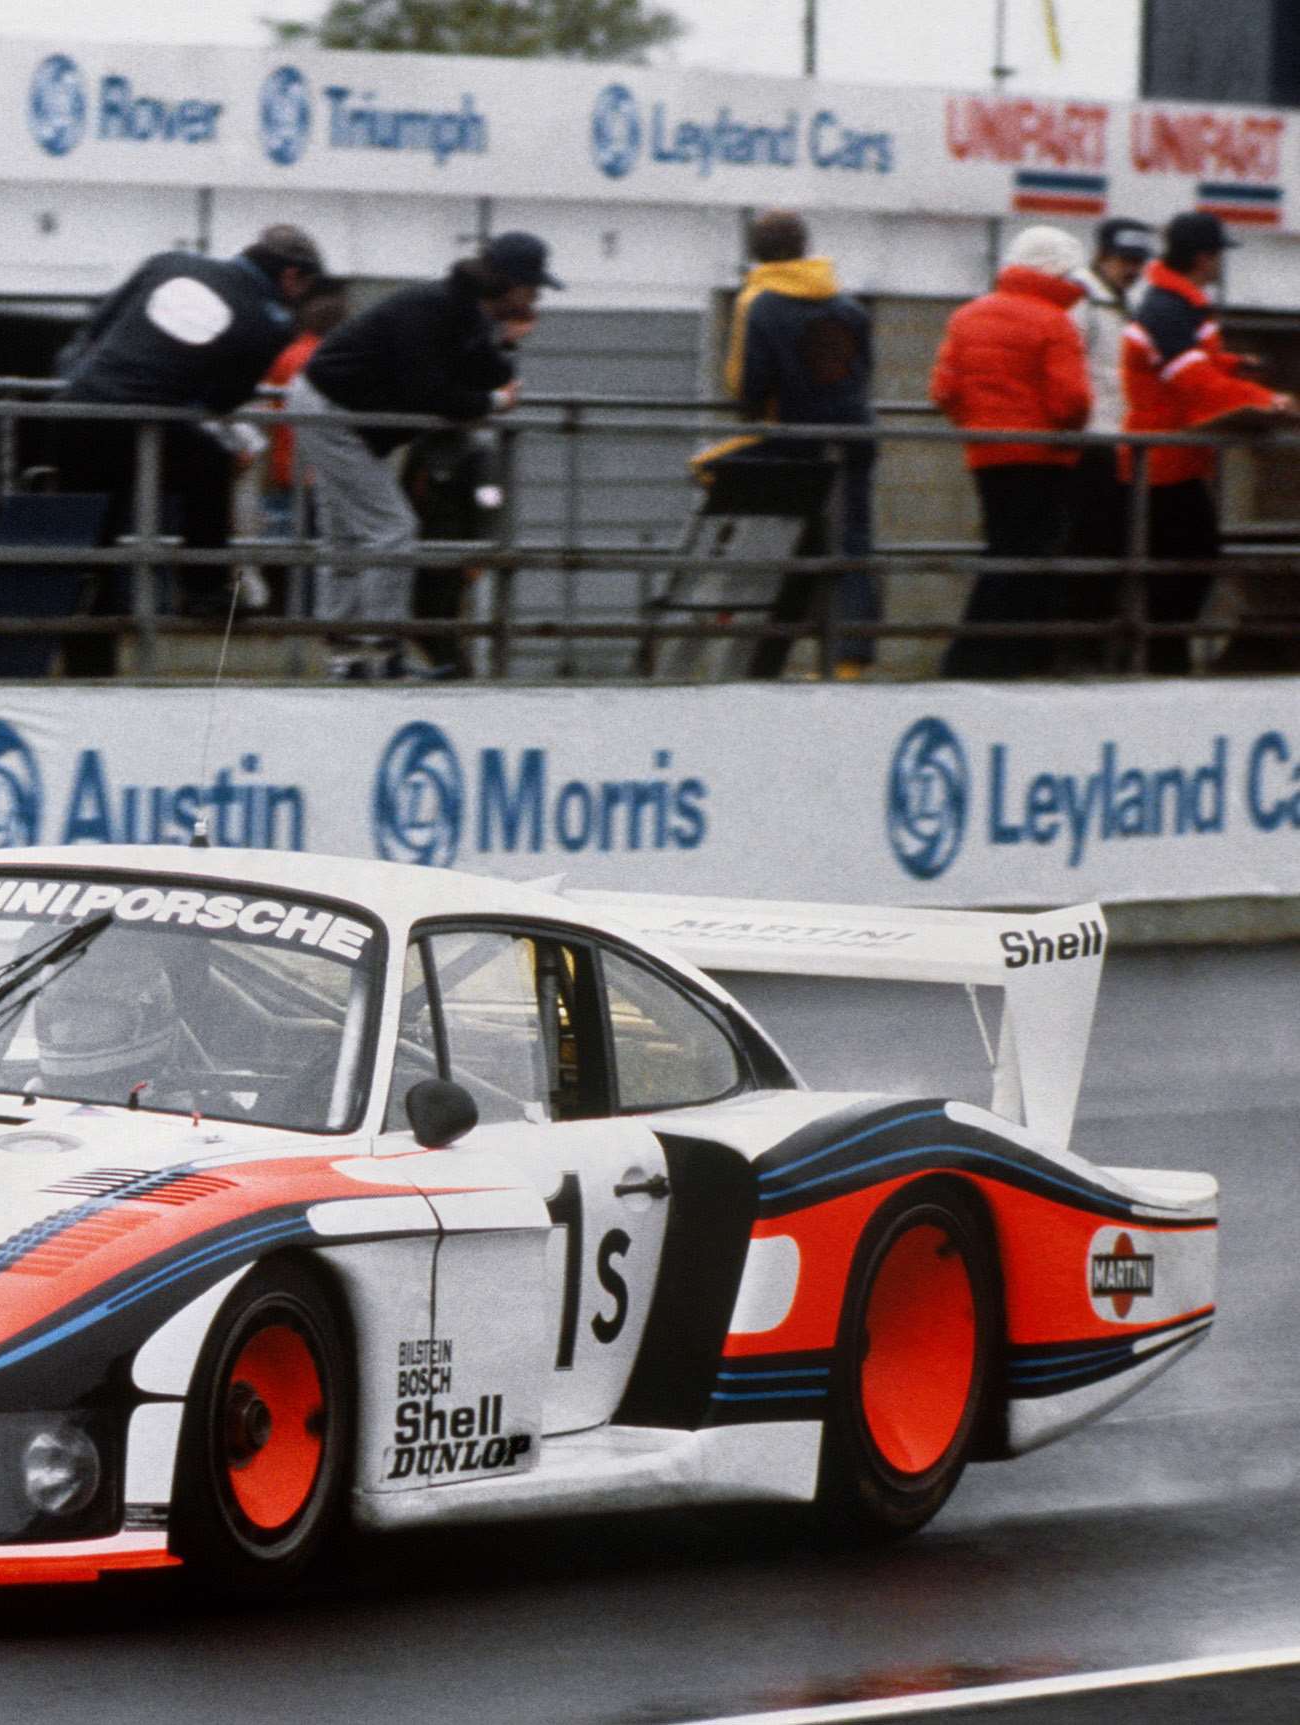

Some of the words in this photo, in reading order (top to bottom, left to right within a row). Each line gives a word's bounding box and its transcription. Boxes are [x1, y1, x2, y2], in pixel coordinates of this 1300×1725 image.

[96, 74, 221, 145] Rover
[324, 85, 487, 163] Triumph
[649, 105, 798, 175] Leyland
[810, 111, 893, 174] Cars
[60, 747, 306, 852] Austin
[473, 747, 712, 854] Morris
[987, 735, 1230, 867] Leyland
[1246, 730, 1300, 833] C
[1001, 920, 1102, 969] Shell
[398, 1366, 452, 1398] BOSCH
[399, 1339, 453, 1366] BILSTEIN
[395, 1394, 503, 1445] Shell
[387, 1434, 532, 1480] DUNLOP
